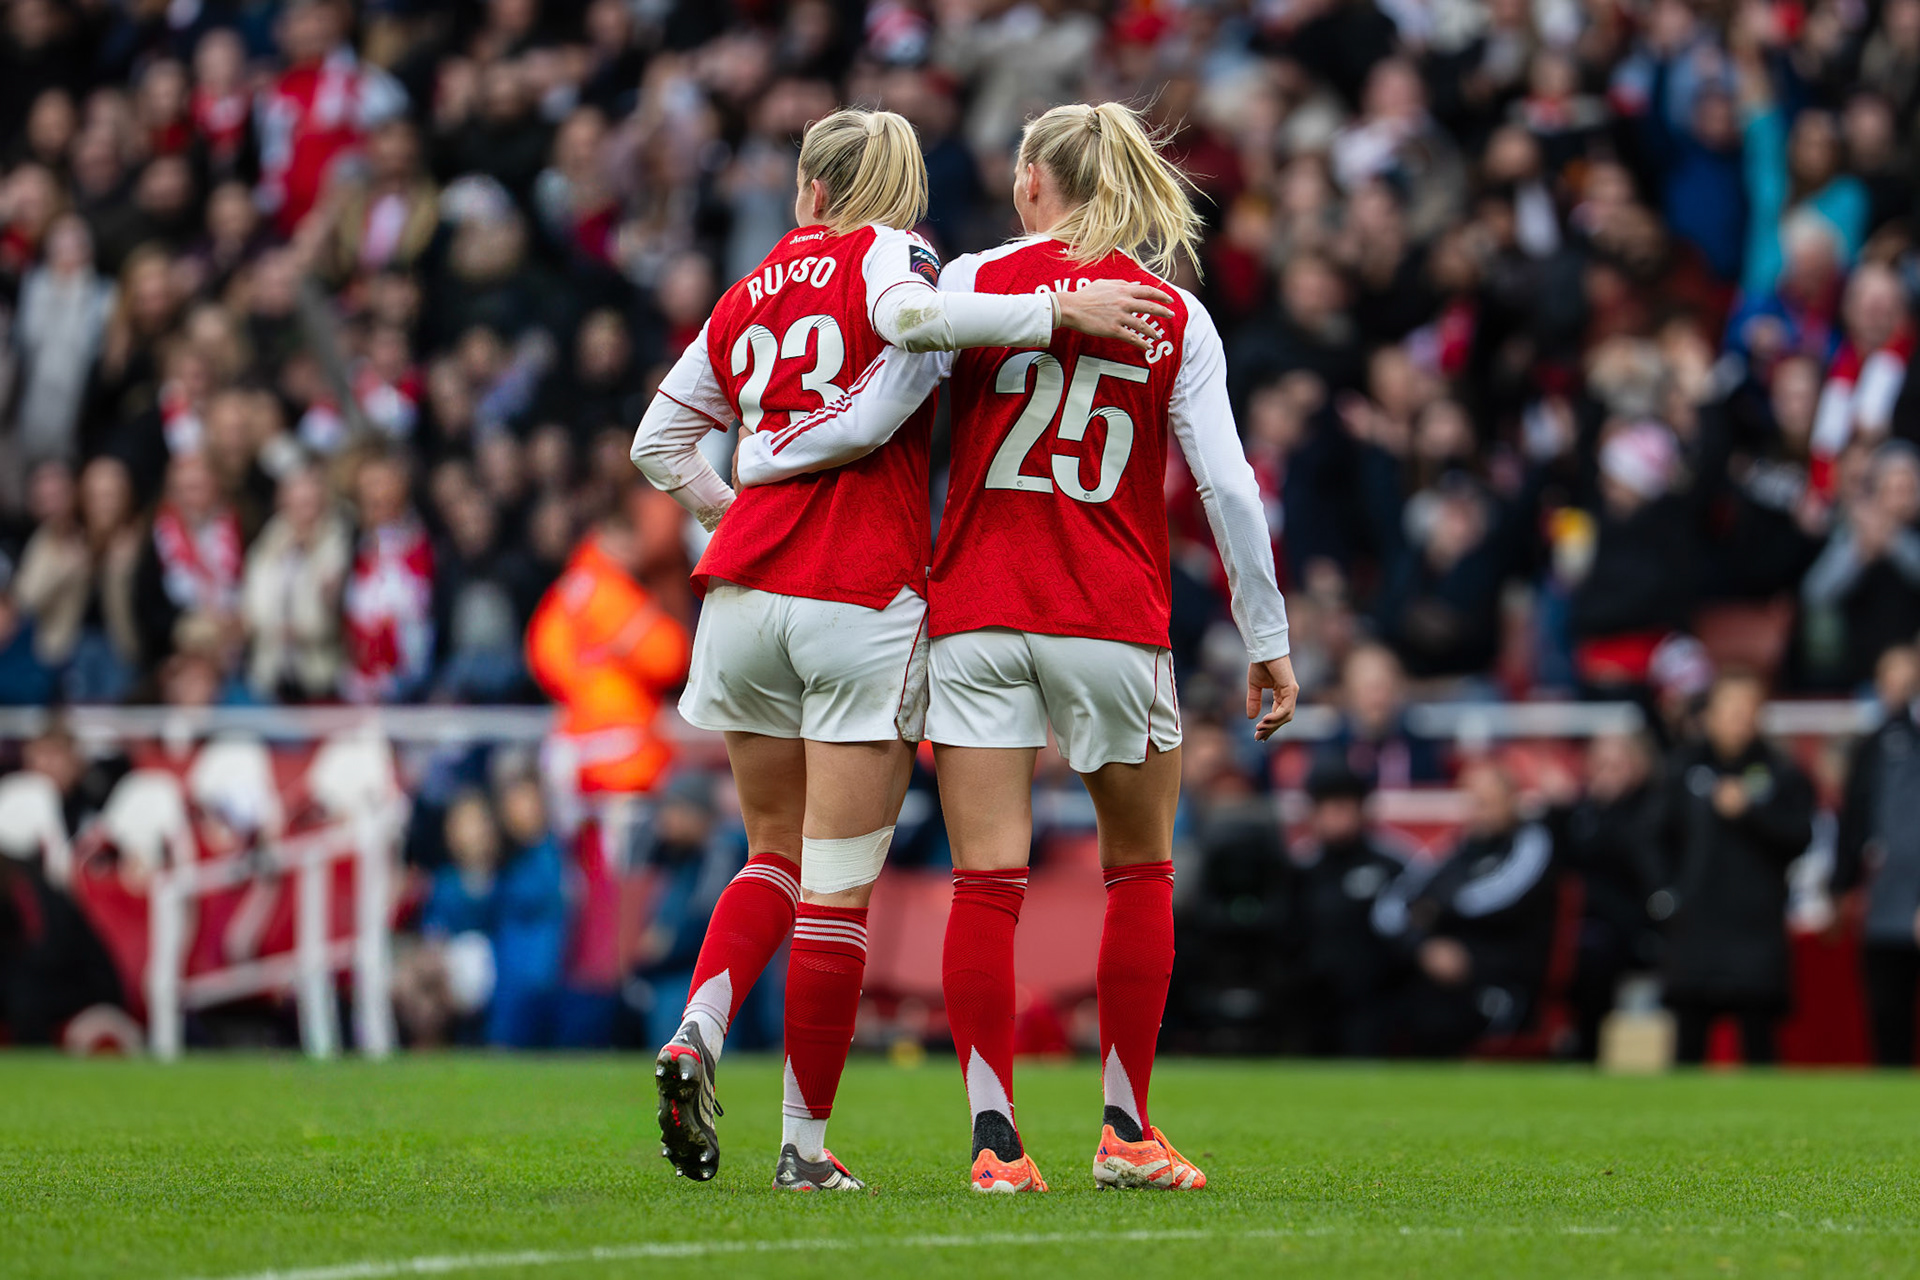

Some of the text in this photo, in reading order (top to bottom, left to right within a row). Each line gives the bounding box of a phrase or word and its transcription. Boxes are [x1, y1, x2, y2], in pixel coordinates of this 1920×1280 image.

[789, 230, 826, 245] Arsenal
[730, 314, 849, 434] 23
[984, 351, 1151, 503] 25
